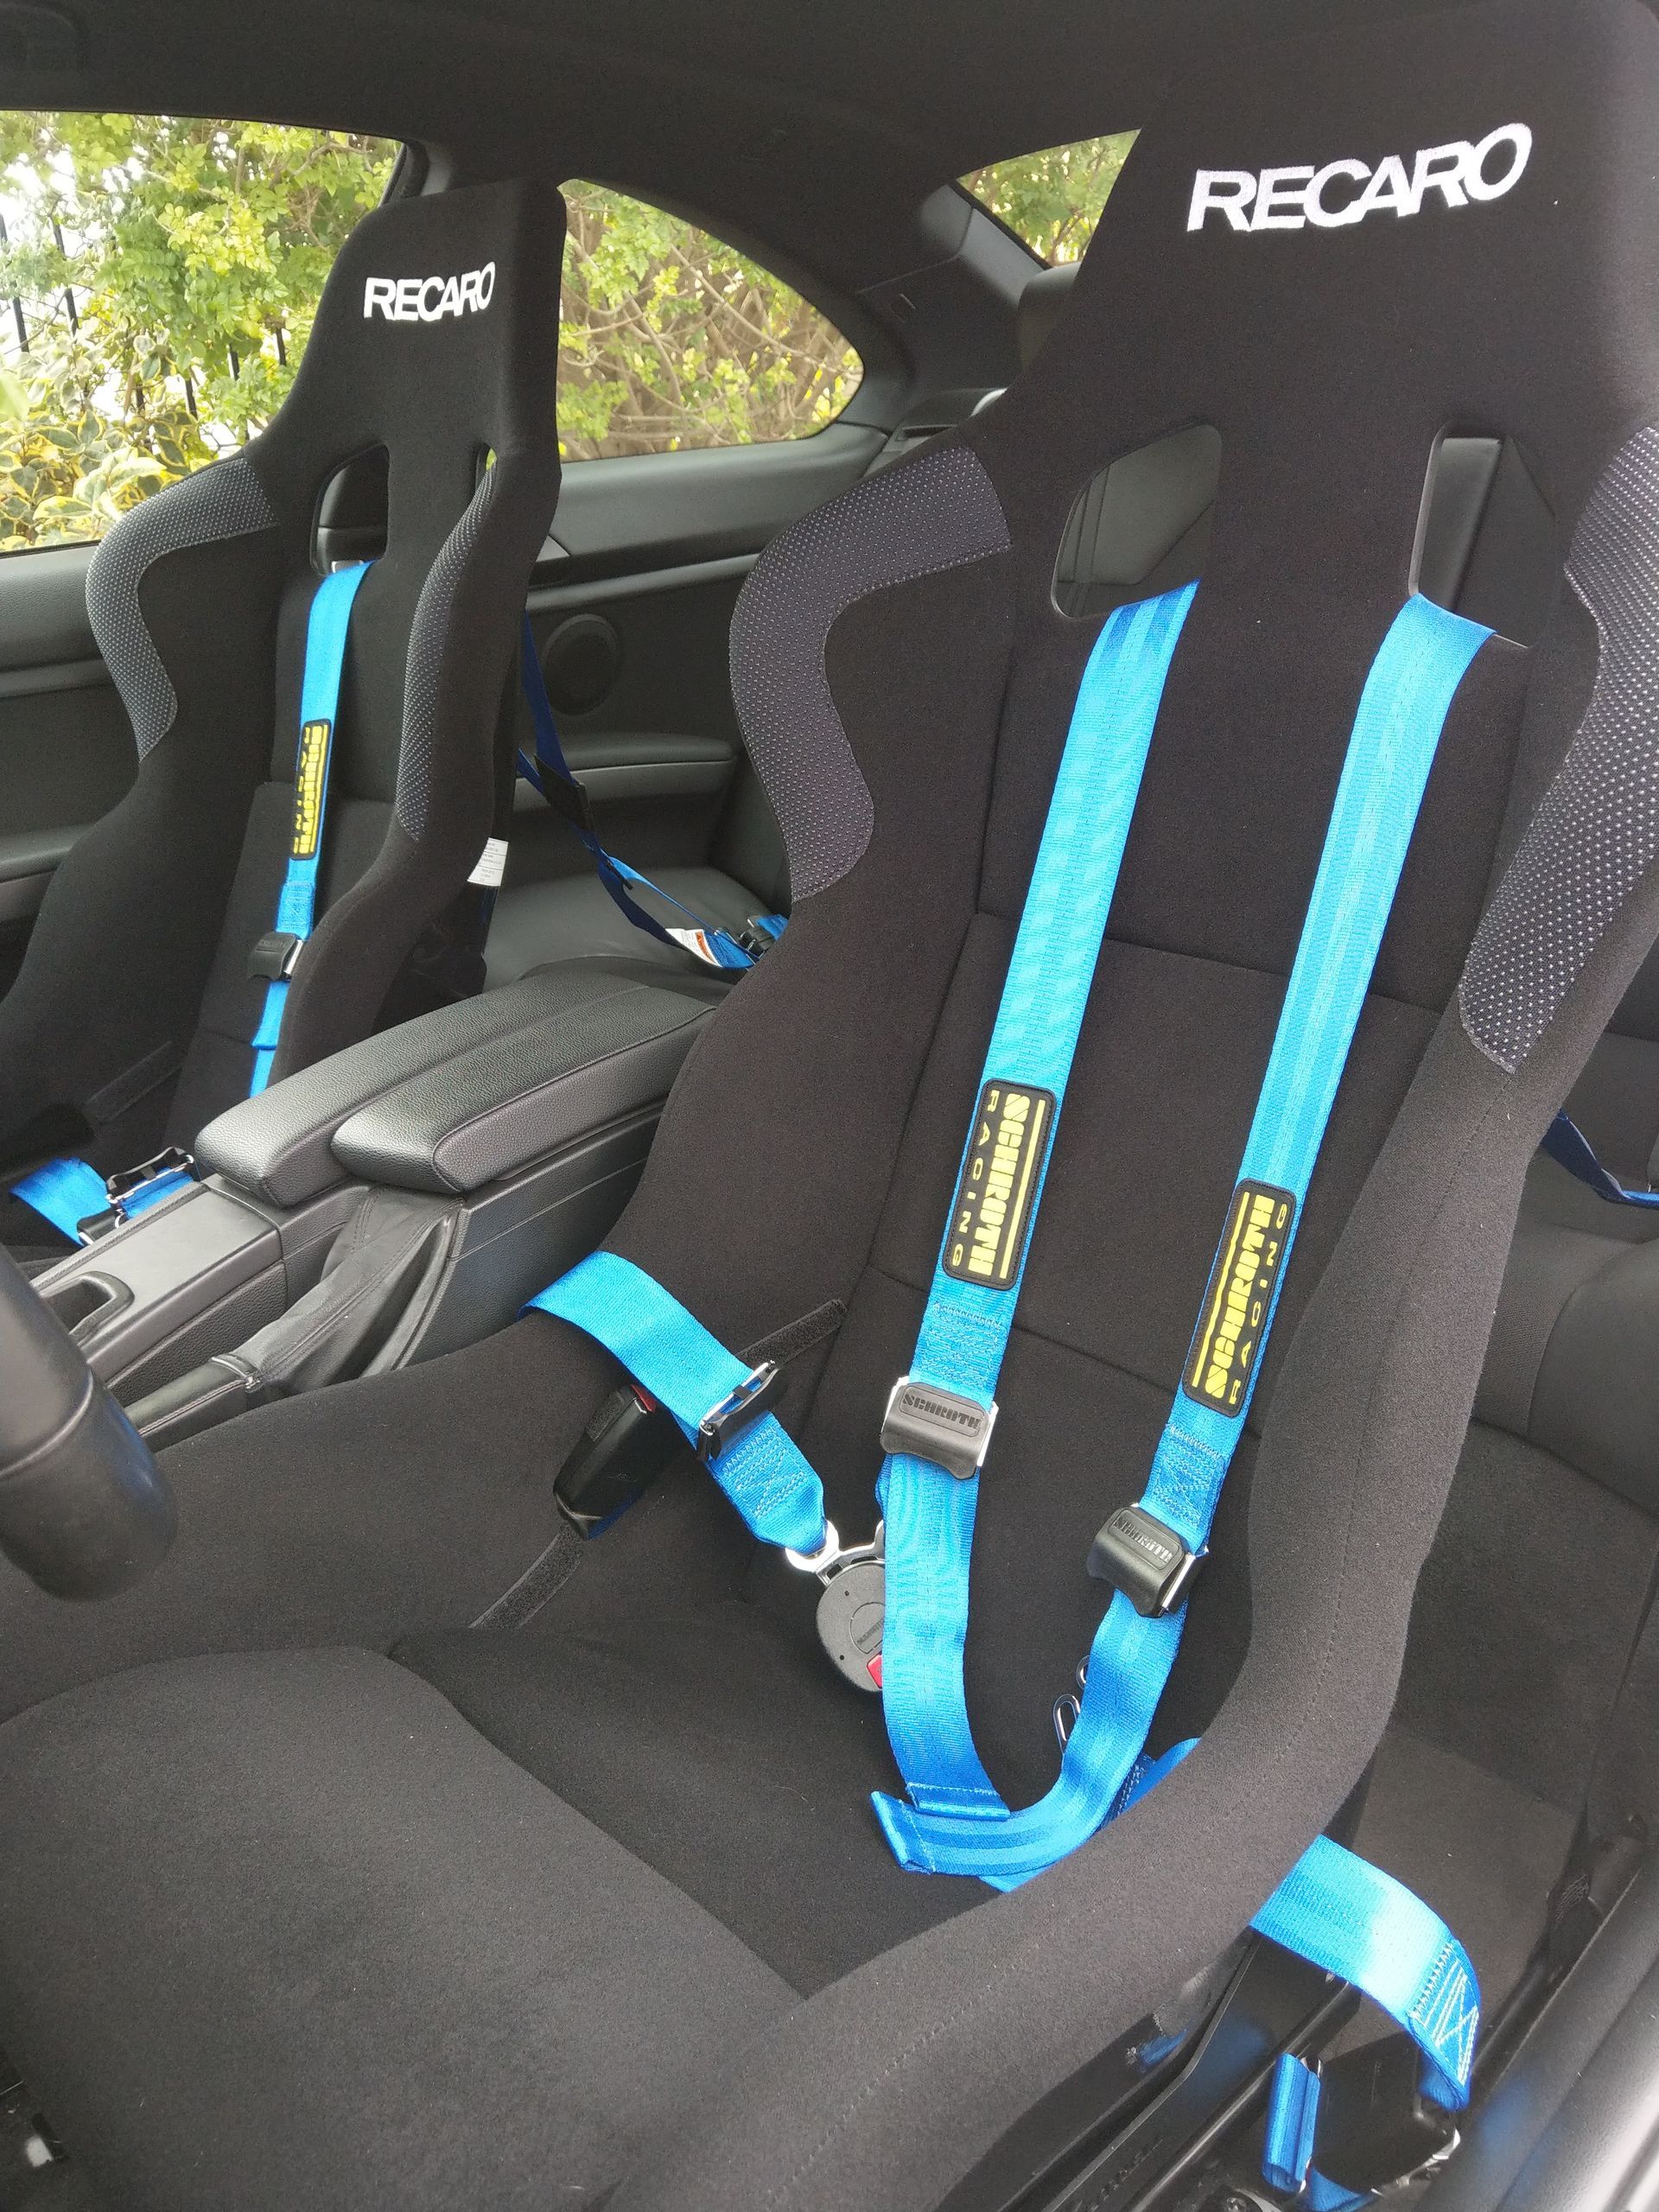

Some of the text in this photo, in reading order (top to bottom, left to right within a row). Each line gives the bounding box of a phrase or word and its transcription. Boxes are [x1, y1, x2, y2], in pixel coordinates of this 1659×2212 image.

[1187, 123, 1533, 232] RECARO
[364, 261, 496, 321] RECARO
[952, 1090, 1000, 1267] RACING
[968, 1093, 1031, 1276] SCHROTH
[1205, 1194, 1275, 1399] SCHROTH
[1229, 1204, 1288, 1405] RACING
[903, 1394, 983, 1429] SCHROTH
[1113, 1517, 1174, 1563] SCHROTH
